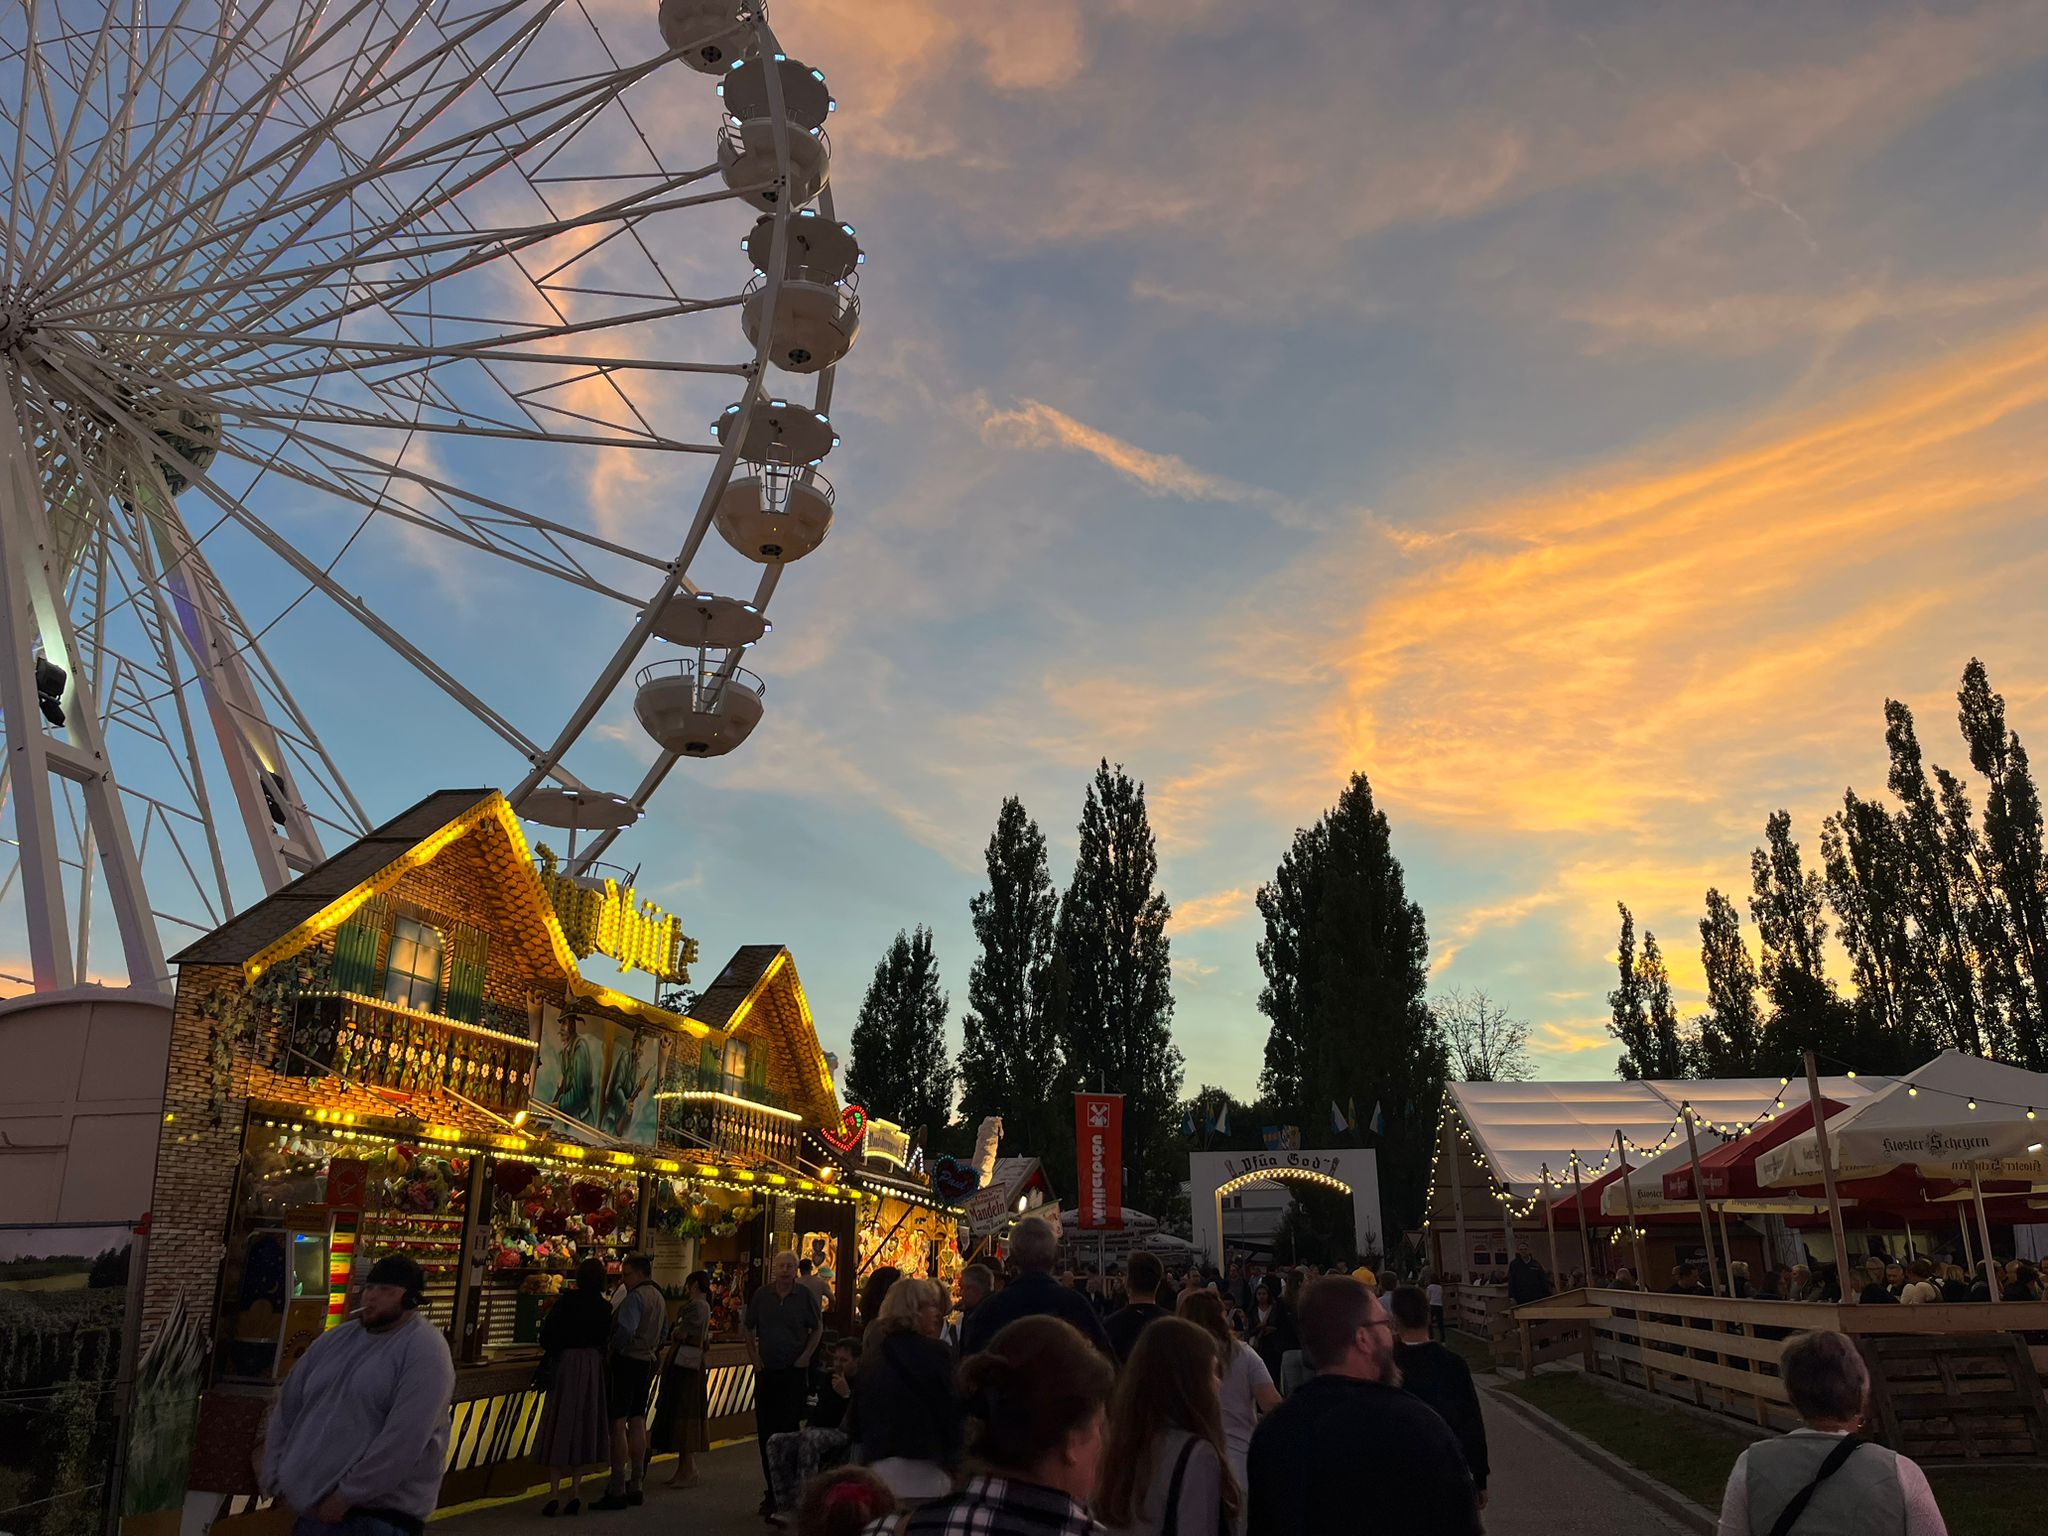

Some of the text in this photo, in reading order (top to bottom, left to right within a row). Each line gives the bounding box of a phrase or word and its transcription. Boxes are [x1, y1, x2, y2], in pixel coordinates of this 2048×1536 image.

[1883, 1133, 1990, 1152] Kloster Scheyern
[969, 1201, 1005, 1221] Mandeln
